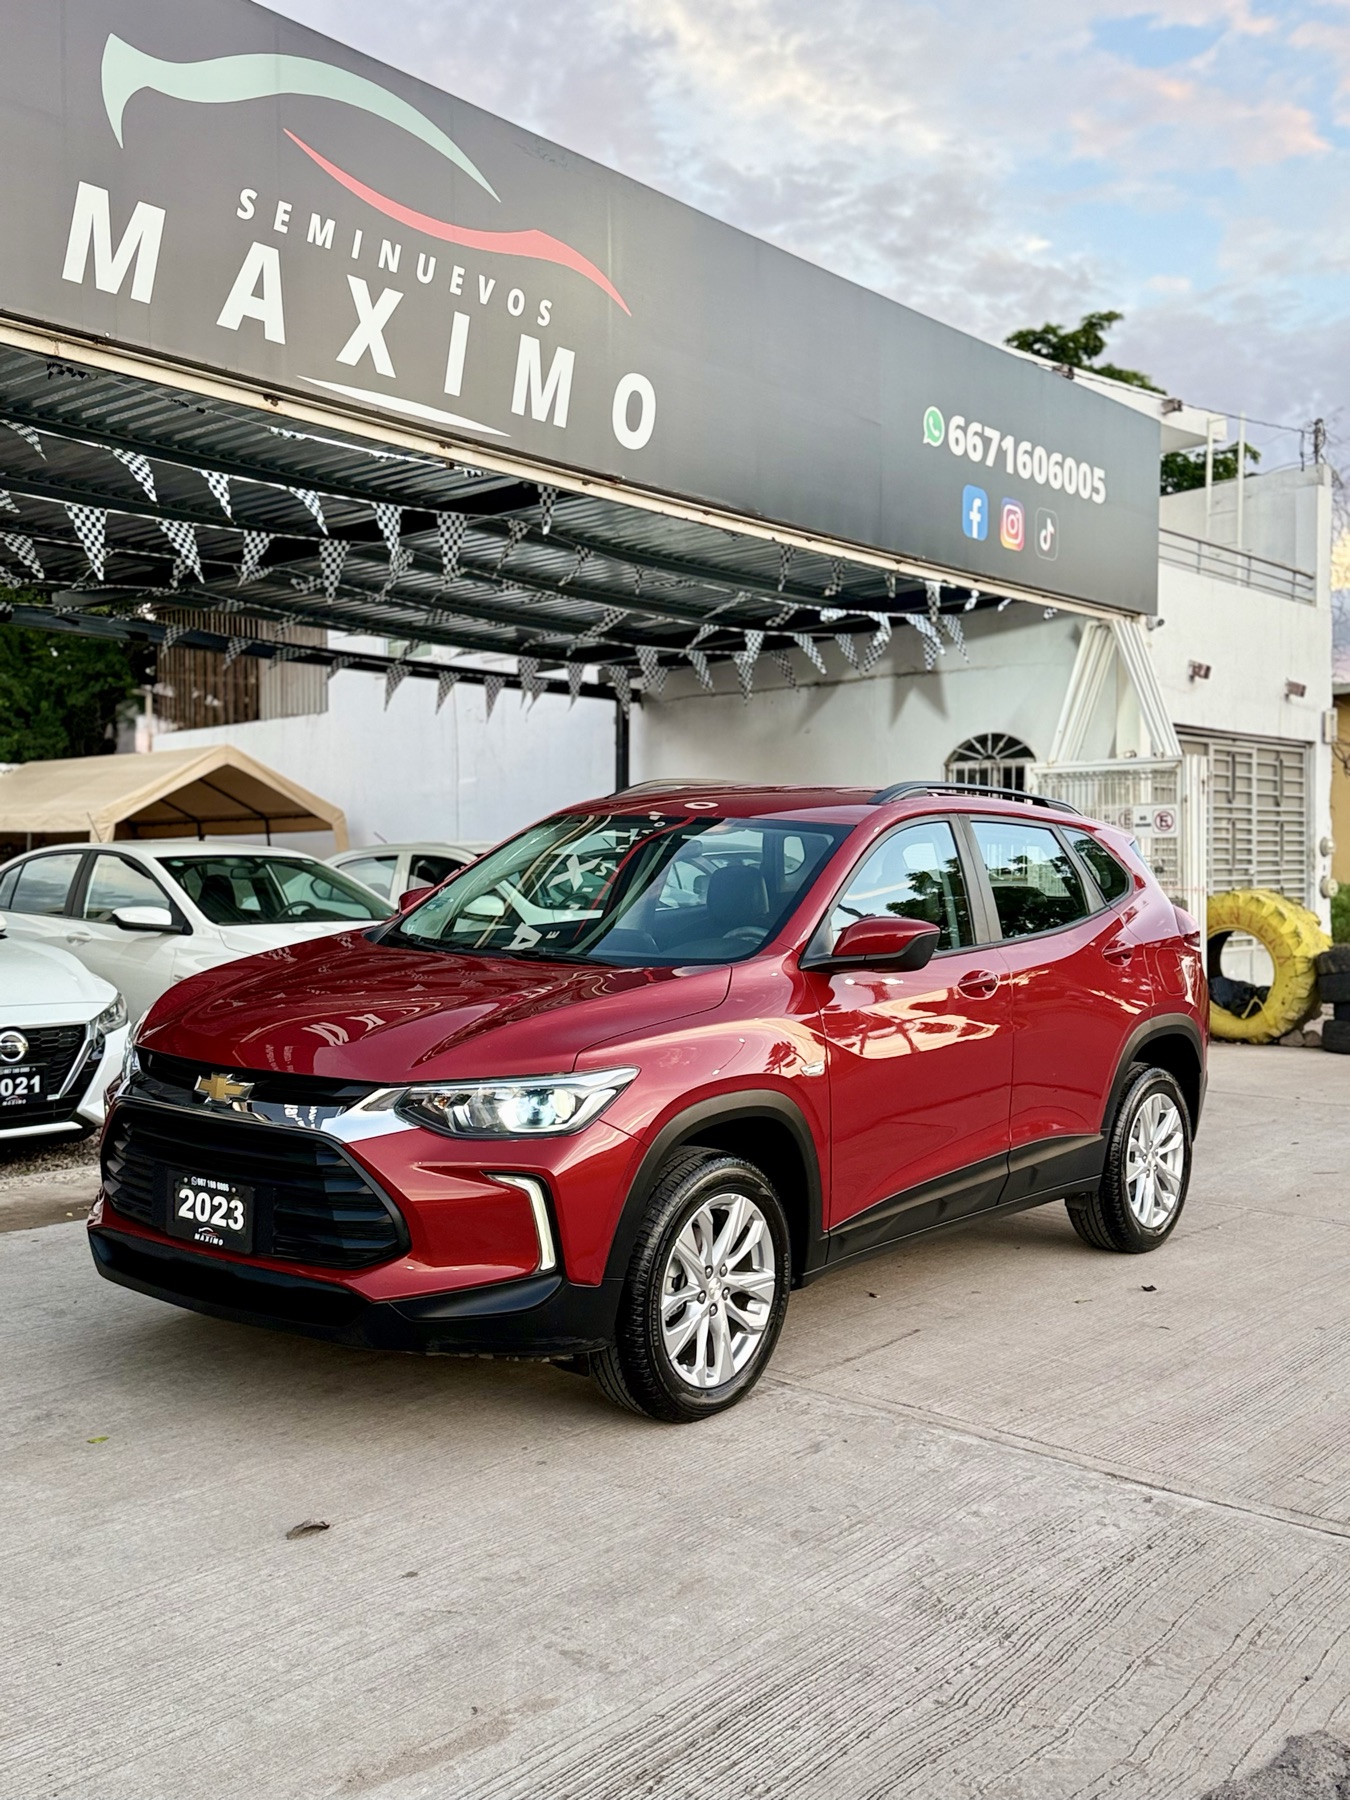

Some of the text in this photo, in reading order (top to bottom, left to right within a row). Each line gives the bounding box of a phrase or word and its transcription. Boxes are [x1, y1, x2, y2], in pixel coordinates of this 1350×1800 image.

[236, 188, 552, 326] SEMINUEVOS
[62, 181, 656, 450] MAXIMO
[948, 415, 1106, 504] 6671606005
[178, 1188, 244, 1231] 2023
[194, 1233, 223, 1245] MAXIMO
